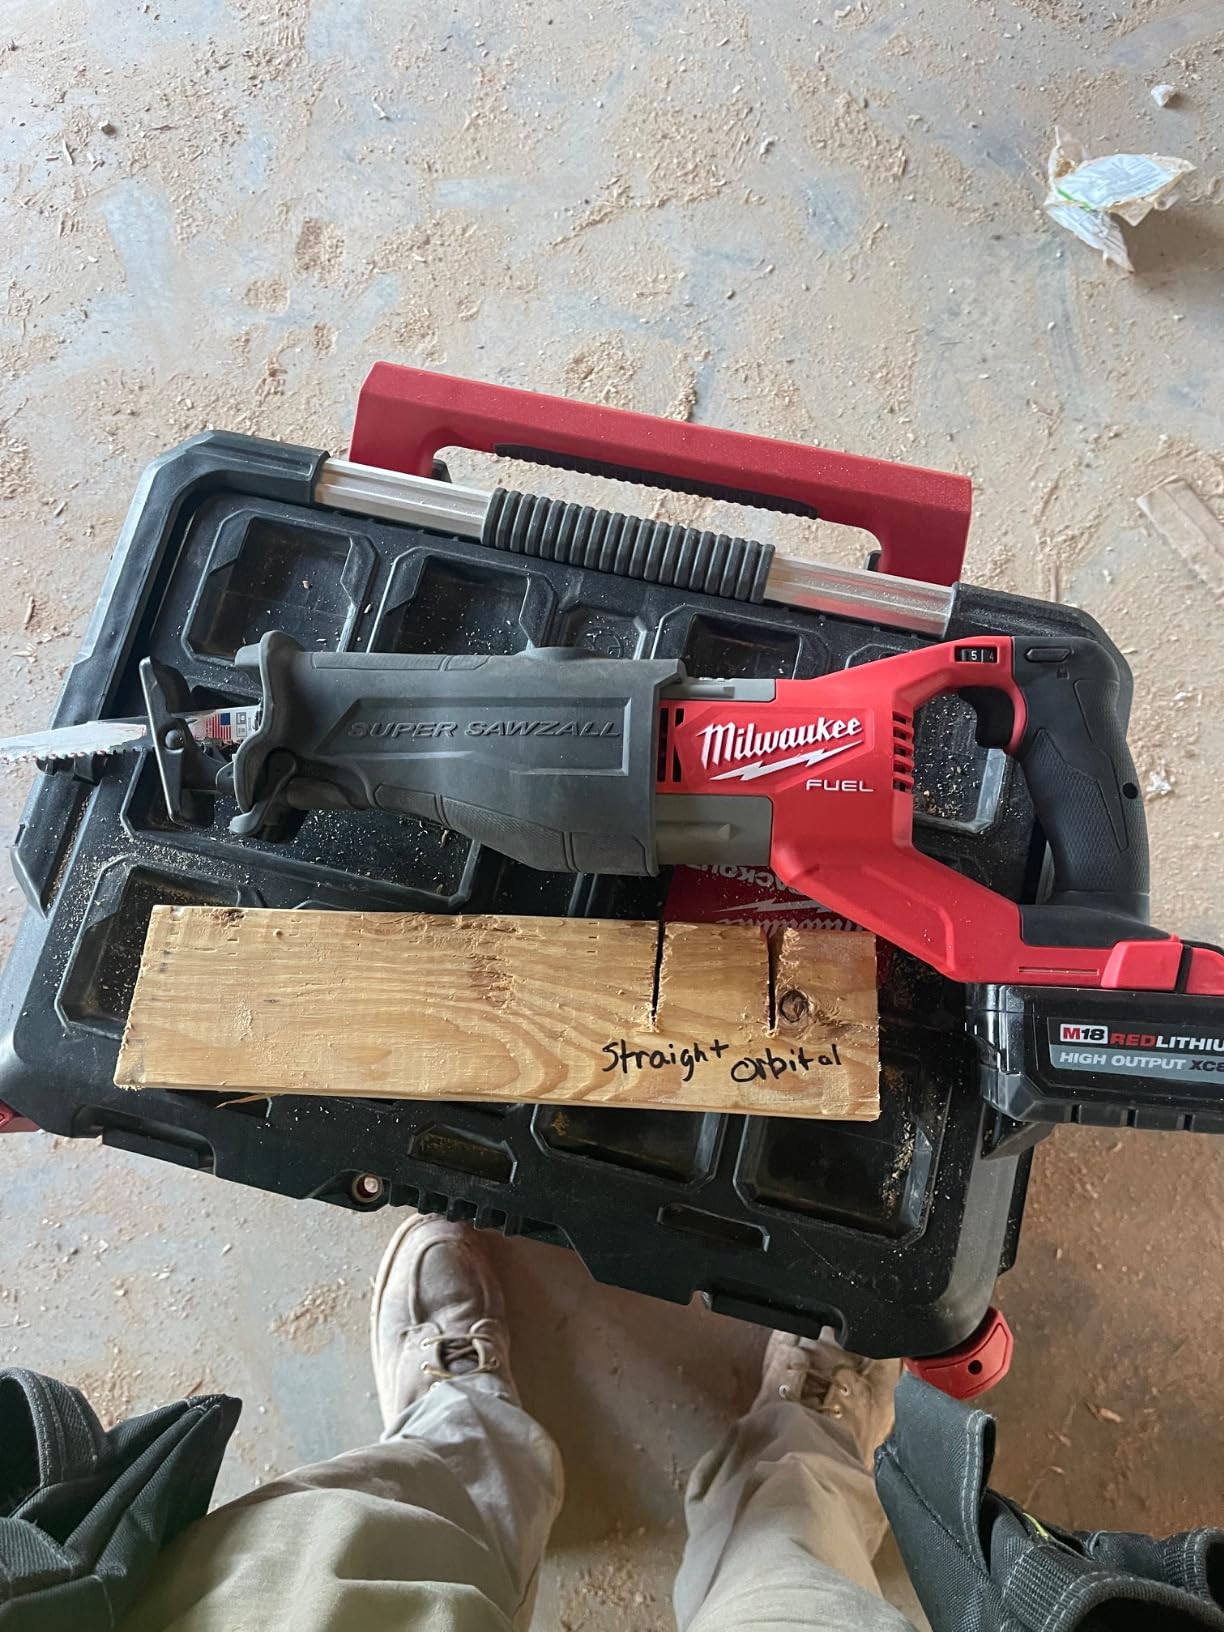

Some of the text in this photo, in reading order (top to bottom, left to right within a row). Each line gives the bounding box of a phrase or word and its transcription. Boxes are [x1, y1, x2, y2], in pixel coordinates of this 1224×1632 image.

[348, 720, 621, 738] SUPER SAWZALL
[696, 717, 863, 770] Milwaukee
[806, 779, 874, 792] FUEL
[1062, 1027, 1105, 1041] M18
[1060, 1052, 1107, 1065] HIGH
[1111, 1055, 1187, 1070] OUTPUT
